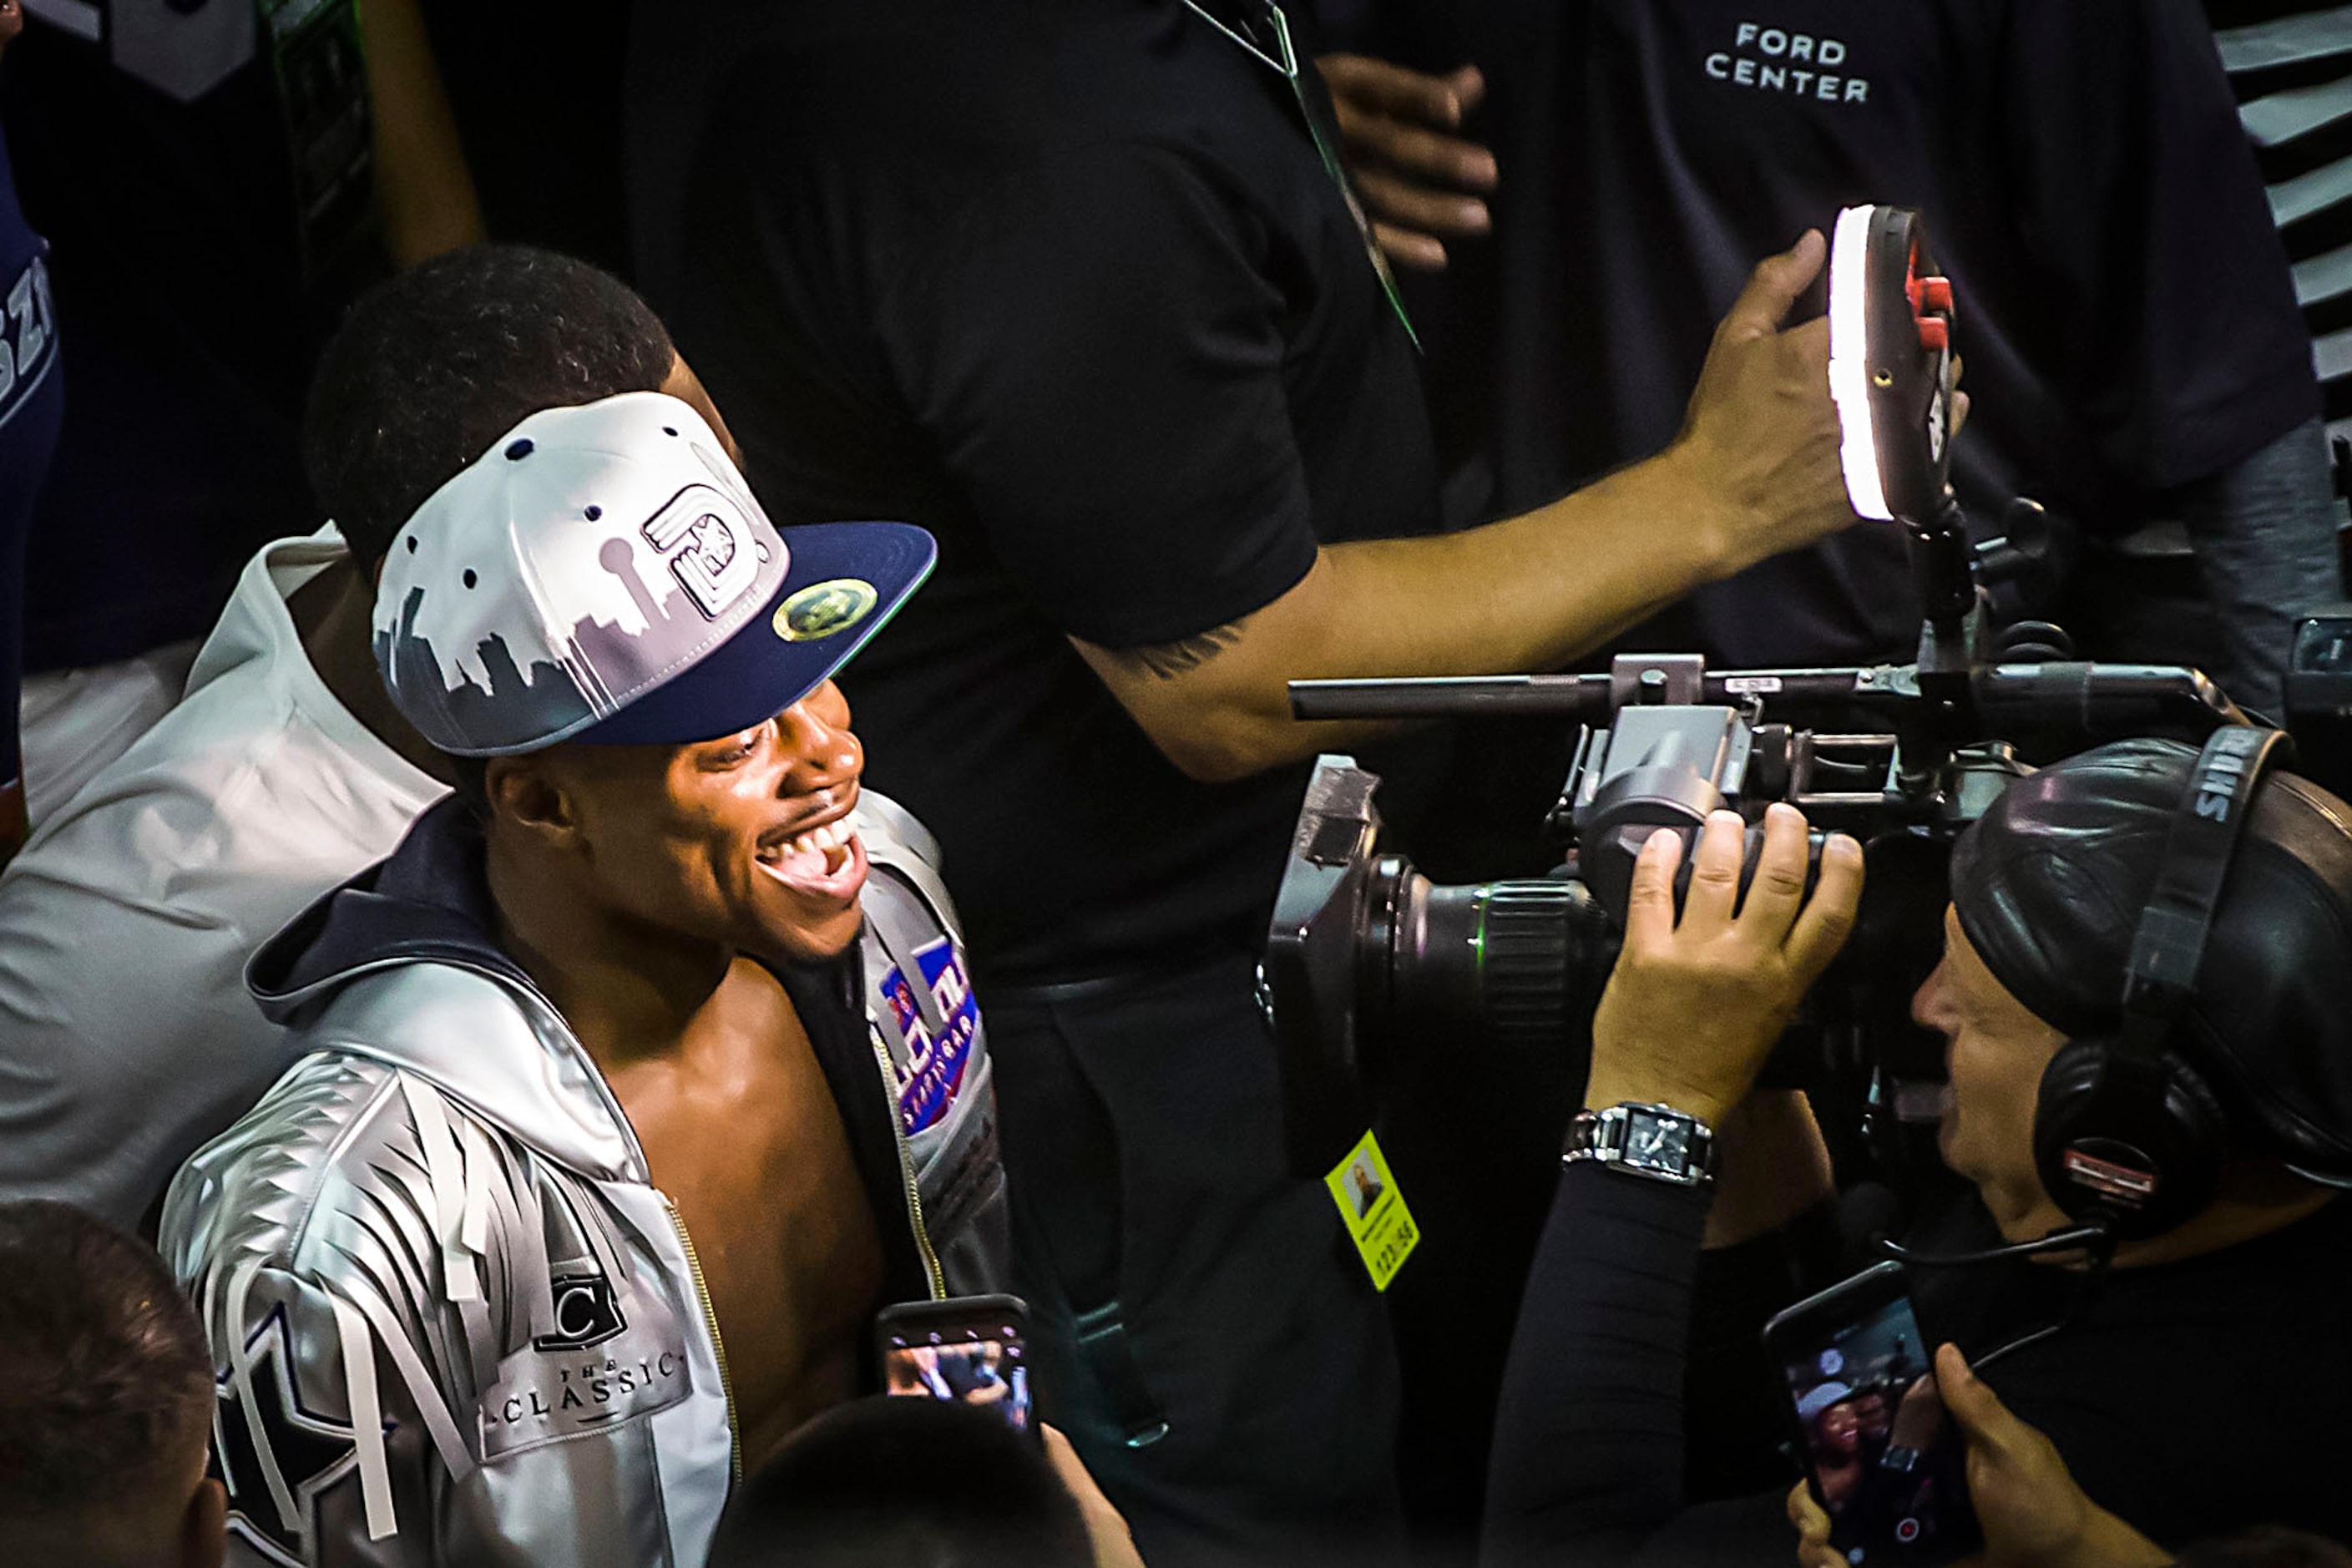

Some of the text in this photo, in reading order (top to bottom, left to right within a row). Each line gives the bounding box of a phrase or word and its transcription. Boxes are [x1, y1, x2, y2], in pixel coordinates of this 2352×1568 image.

[1737, 23, 1846, 65] FORD
[1705, 53, 1869, 103] CENTER
[556, 1286, 596, 1338] C
[503, 1352, 673, 1424] CLASSIC
[560, 1359, 618, 1383] THE
